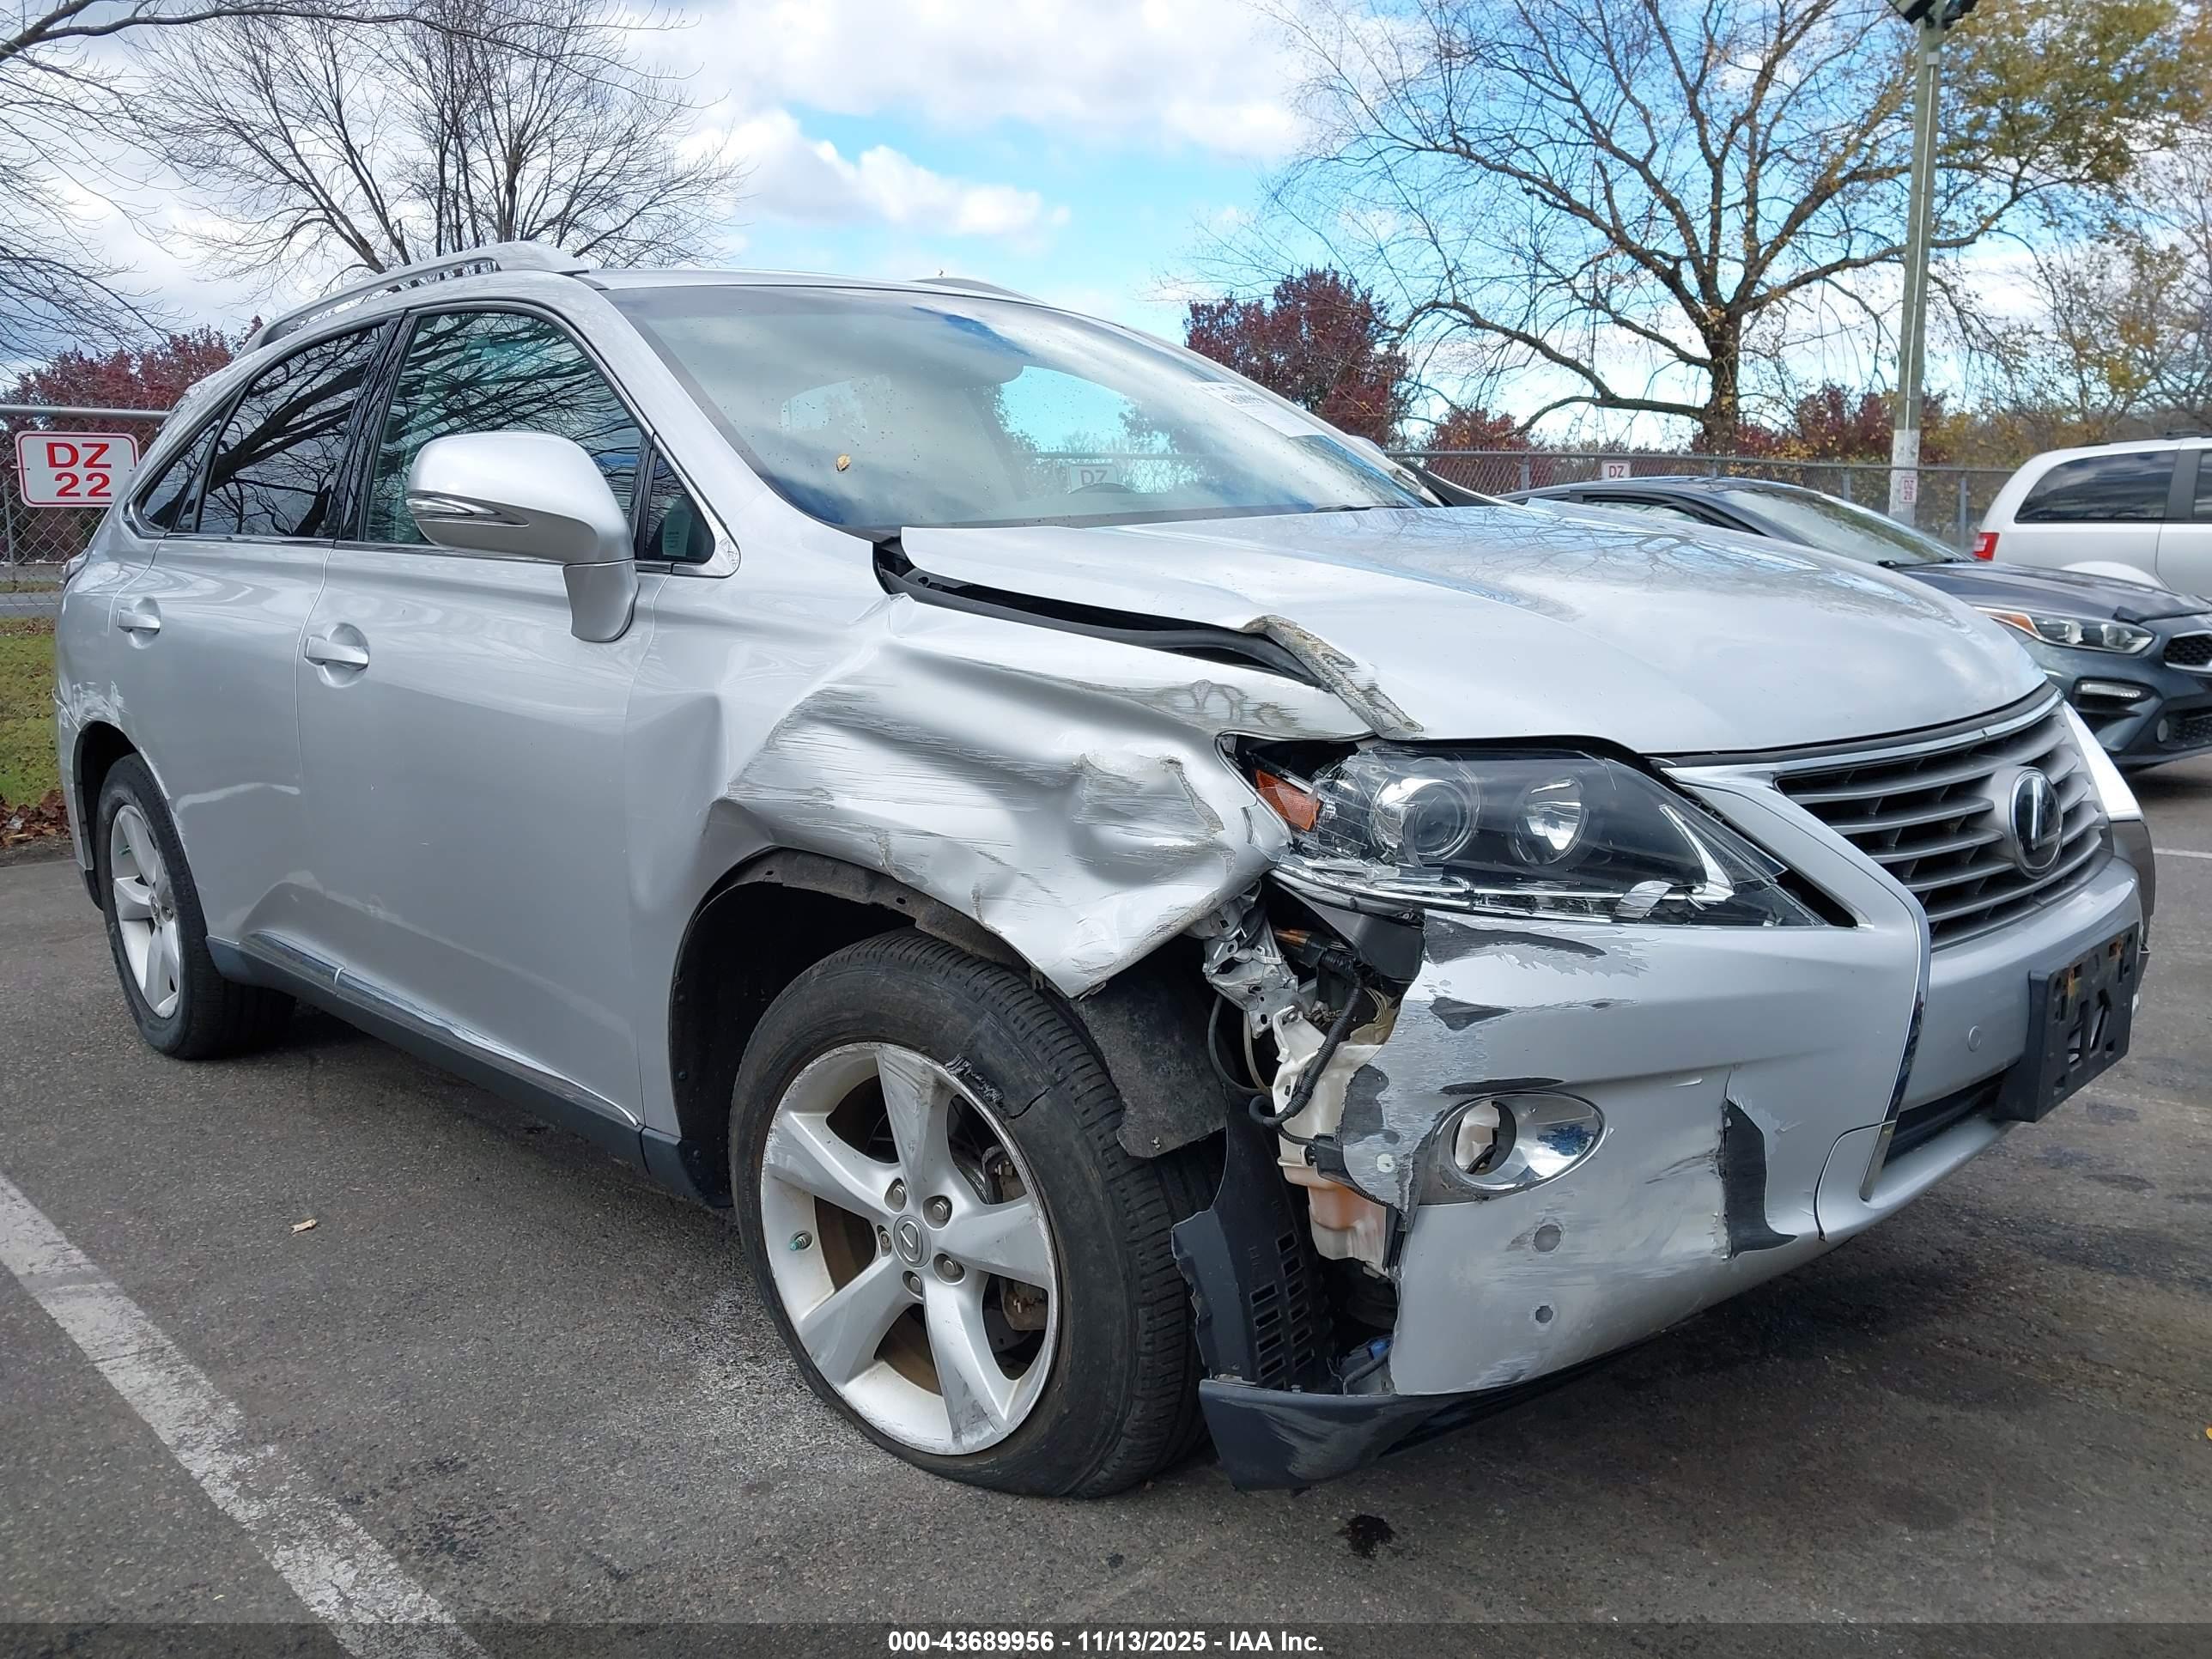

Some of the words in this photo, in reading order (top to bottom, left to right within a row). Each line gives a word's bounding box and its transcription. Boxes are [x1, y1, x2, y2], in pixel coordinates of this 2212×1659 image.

[46, 442, 112, 469] DZ
[1608, 465, 1625, 478] DZ
[54, 472, 112, 497] 22
[1904, 480, 1914, 490] DZ
